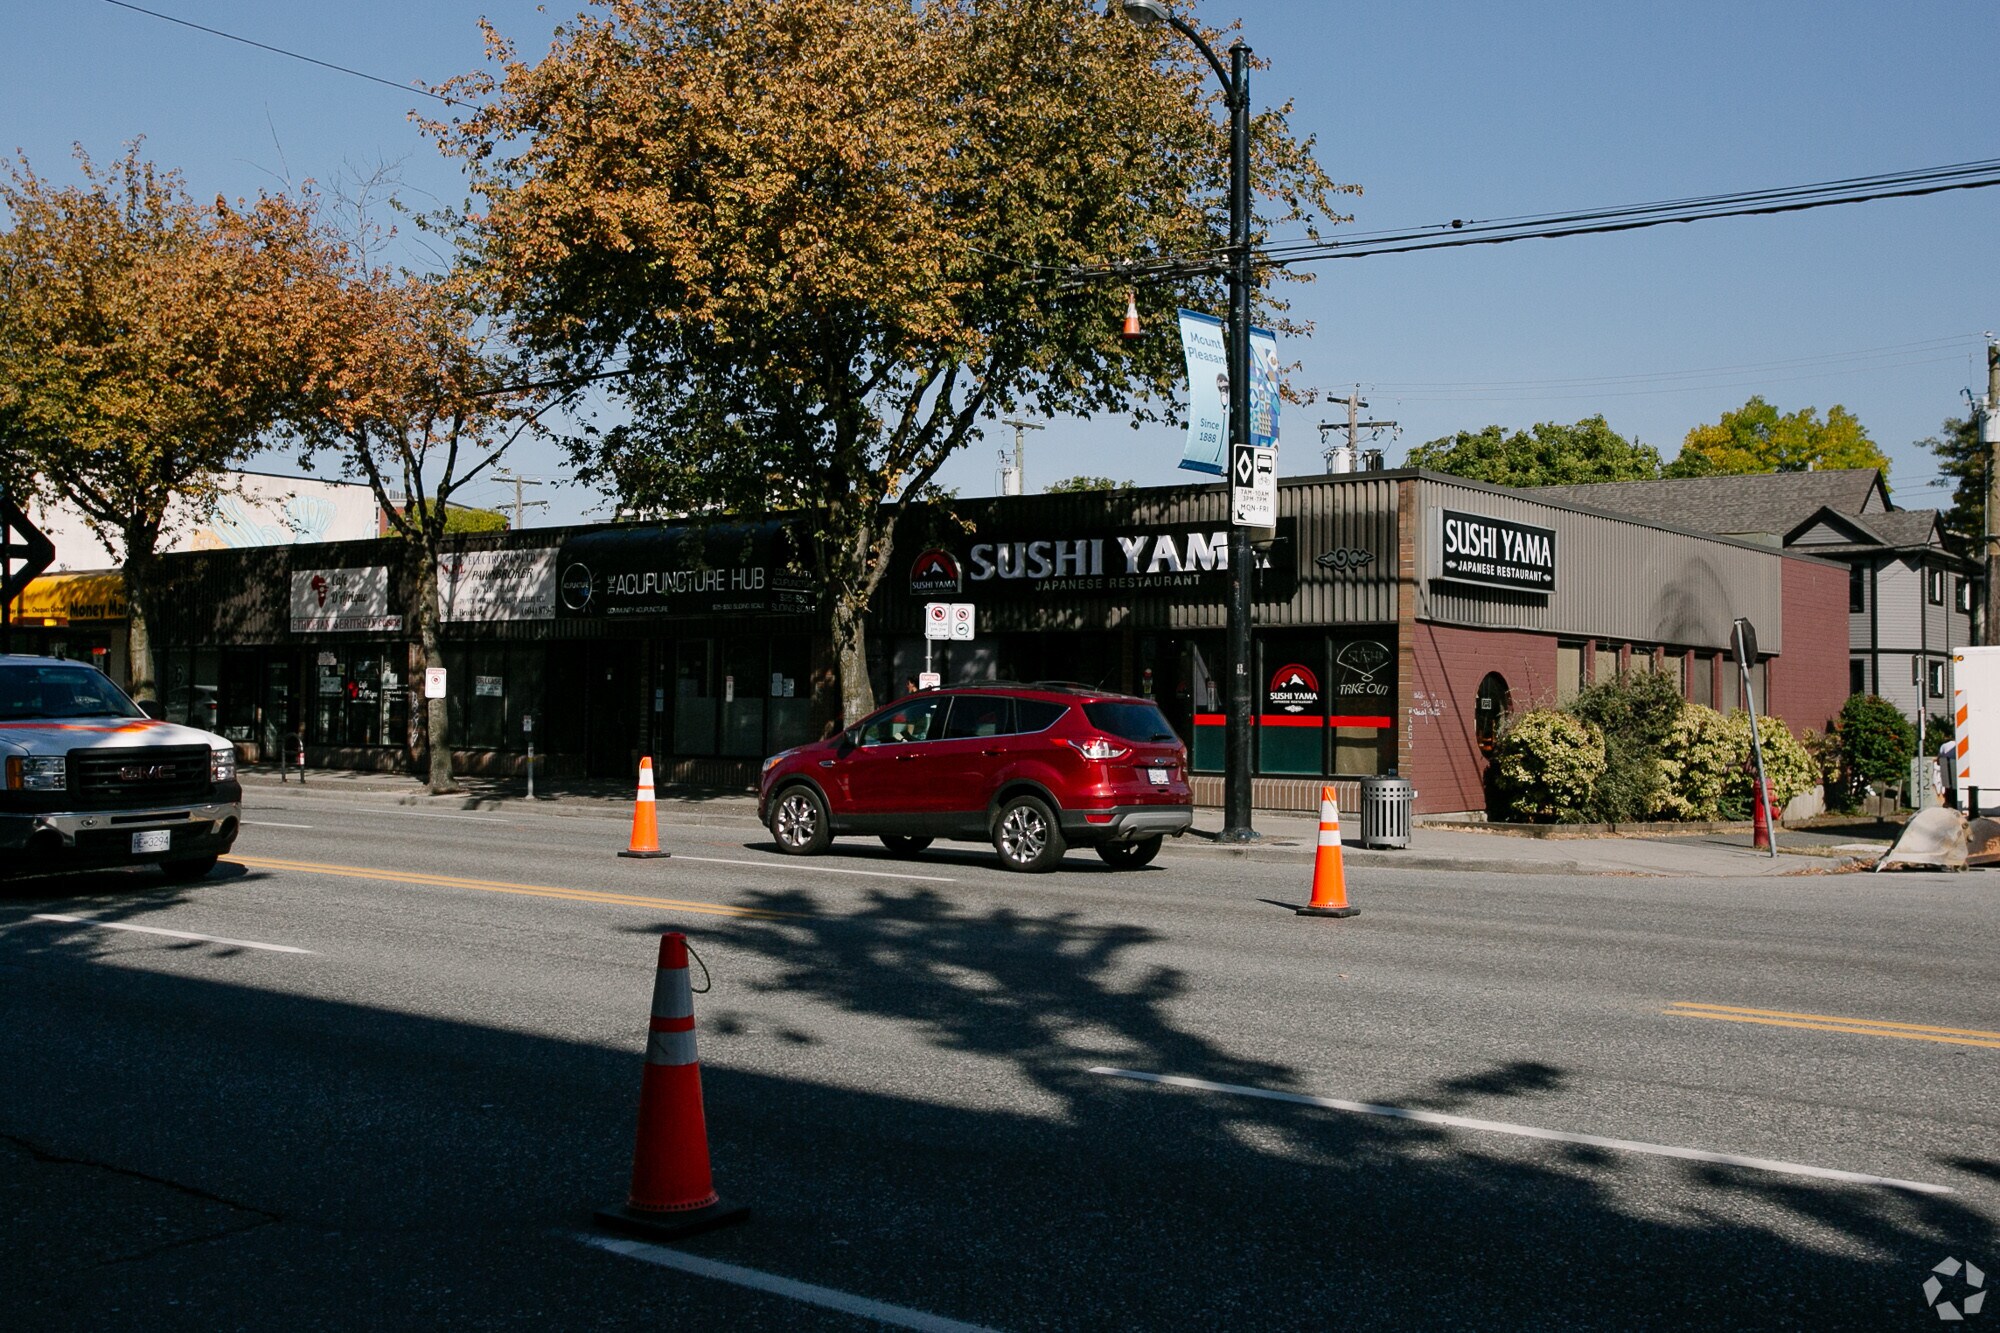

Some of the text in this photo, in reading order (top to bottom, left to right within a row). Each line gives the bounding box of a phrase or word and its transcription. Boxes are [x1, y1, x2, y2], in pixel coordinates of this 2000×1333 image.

[1190, 332, 1222, 350] Mount
[1187, 346, 1226, 365] Pleasan
[1200, 418, 1220, 430] Since
[1199, 432, 1217, 443] 1888
[1241, 504, 1269, 512] MON-FRI
[1445, 519, 1552, 567] SUSHI YAMA
[970, 532, 1271, 580] SUSHI YAM
[1458, 560, 1542, 582] JAPANESE RESTAURANT
[607, 567, 764, 596] THE ACUPUNCTURE HUB
[912, 580, 957, 590] SUSHI YAMA
[1035, 575, 1201, 592] JAPANESE RESTAURANT
[70, 601, 107, 619] Money
[1270, 692, 1318, 700] SUSHI YAMA
[1340, 683, 1366, 695] TAKE
[121, 765, 176, 781] GMC
